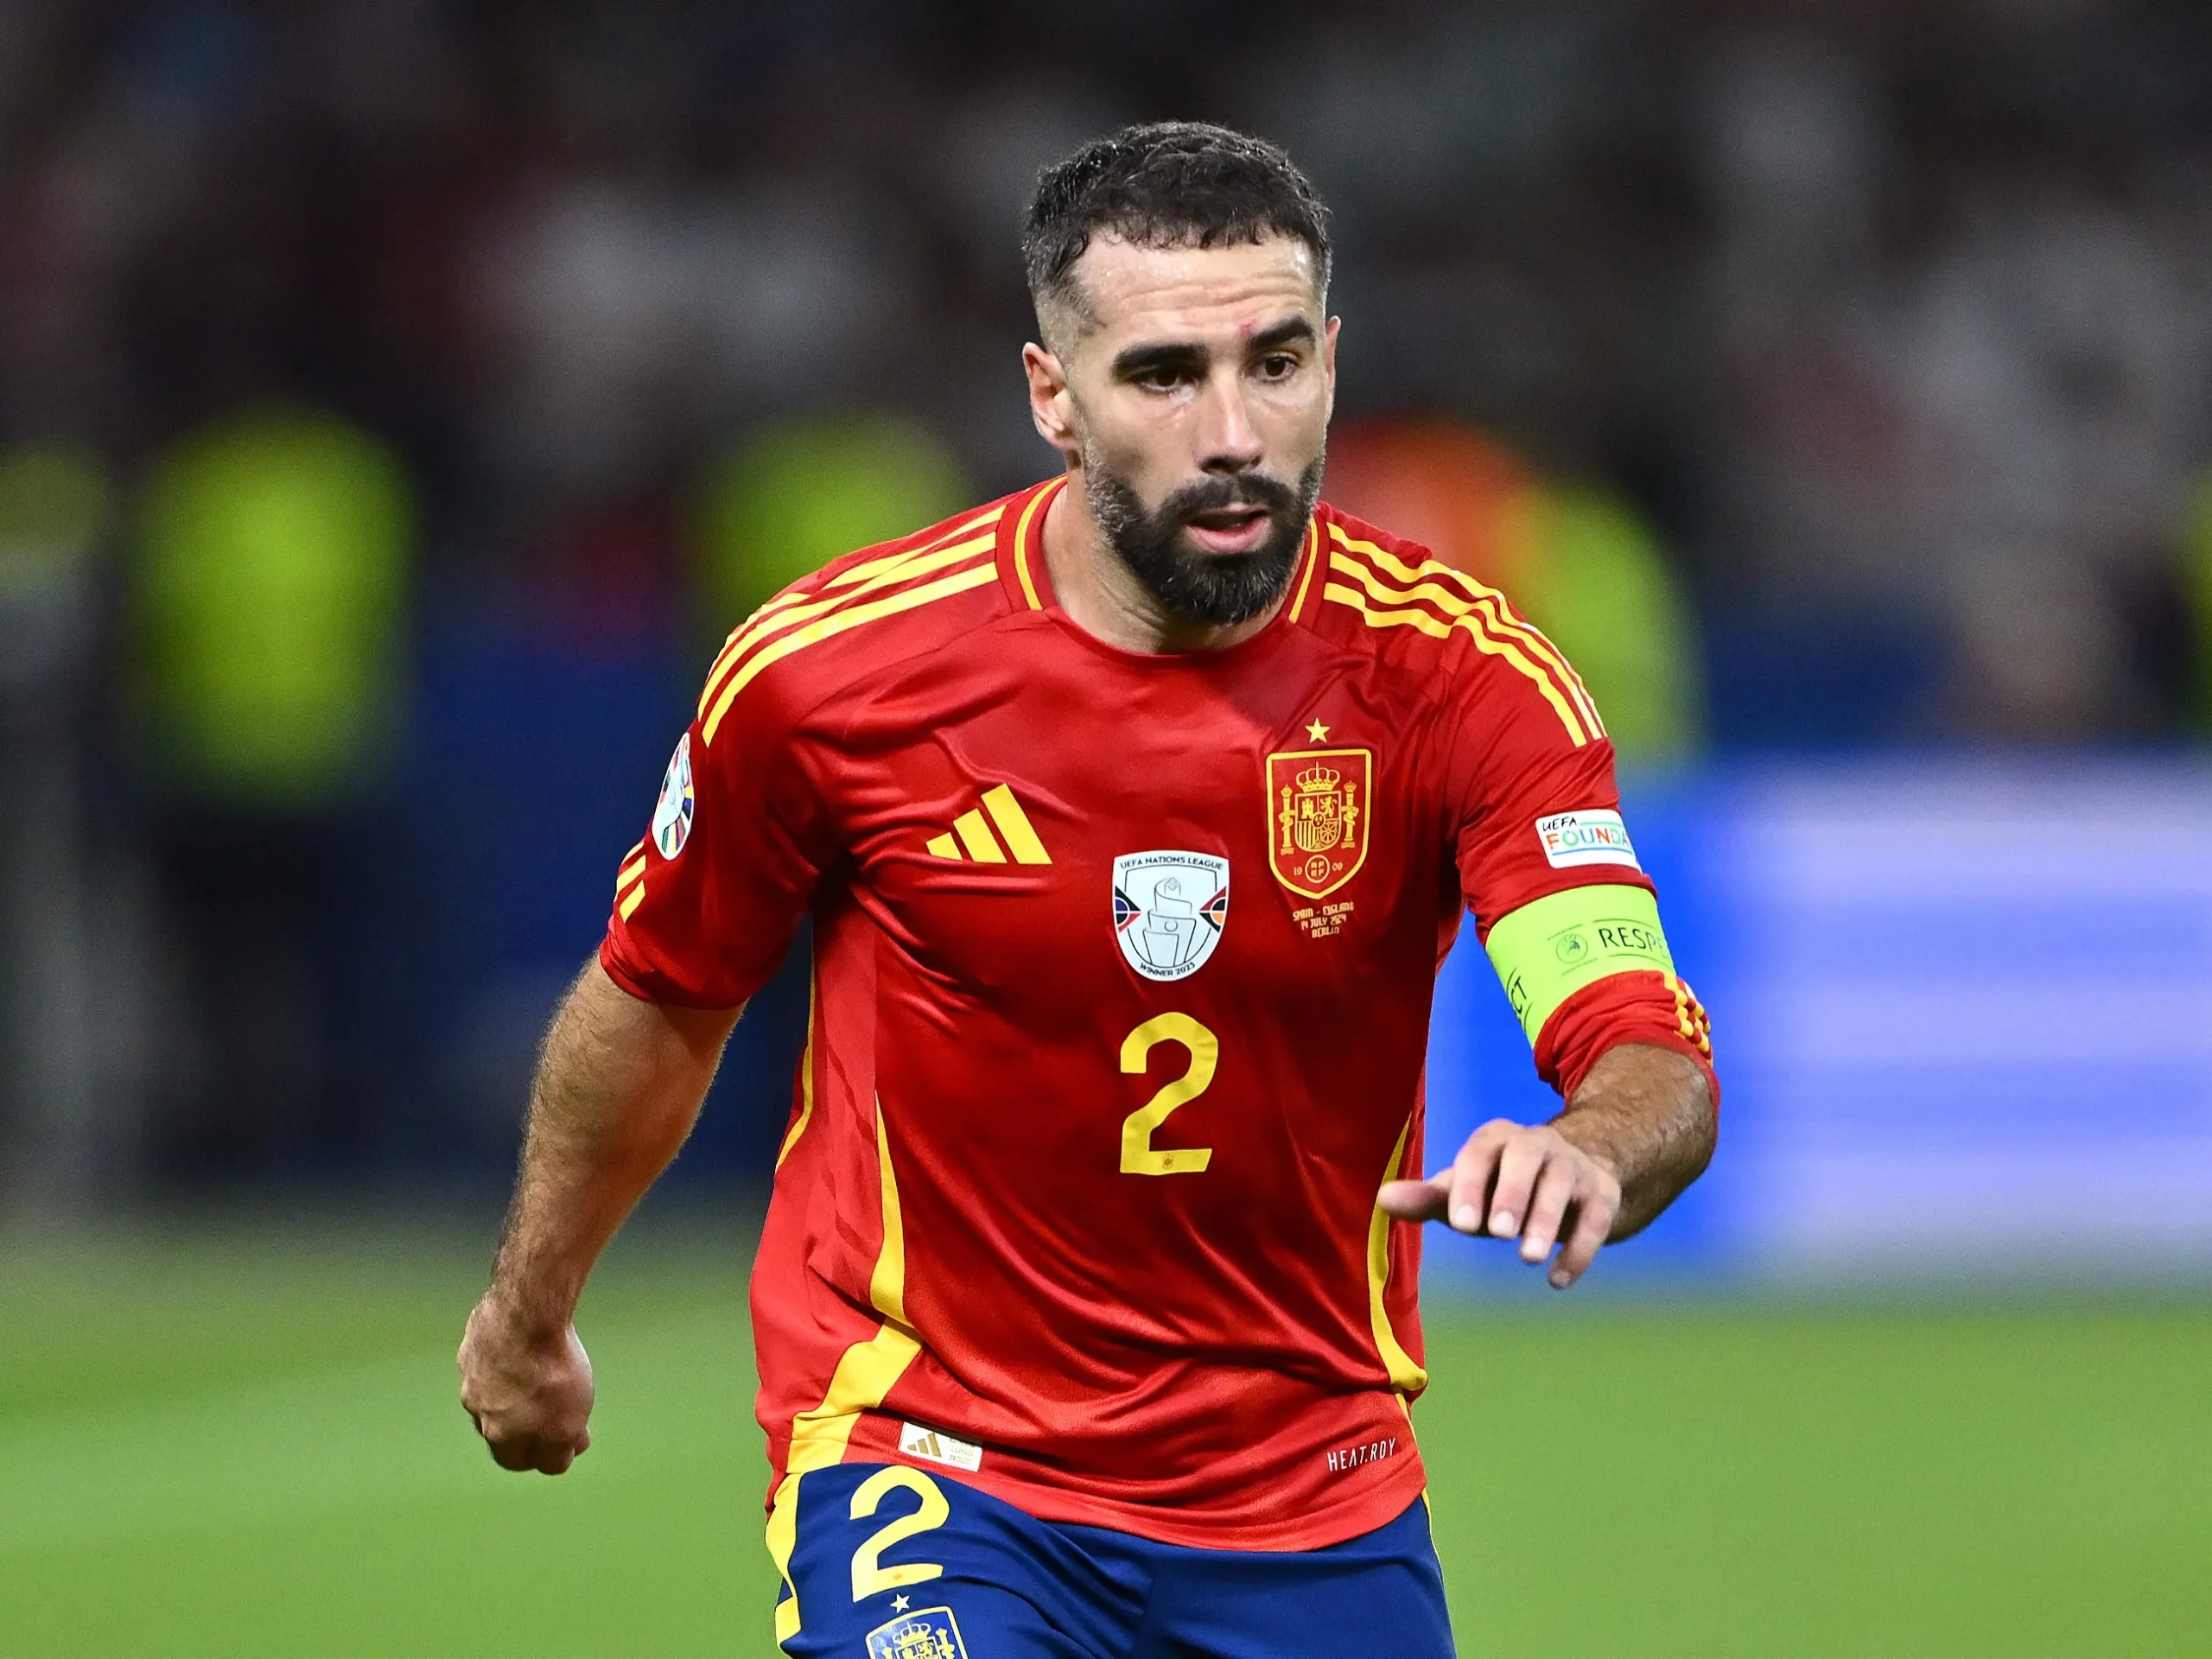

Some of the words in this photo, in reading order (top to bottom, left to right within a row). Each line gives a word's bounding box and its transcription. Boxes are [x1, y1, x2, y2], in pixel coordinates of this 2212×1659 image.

[1542, 816, 1577, 831] UEFA
[1120, 857, 1143, 869] UEFA
[1145, 855, 1185, 864] NATIONS
[1187, 857, 1224, 870] LEAGUE
[1293, 907, 1314, 922] SPAIN
[1322, 901, 1355, 916] ENGLAND
[1310, 917, 1328, 929] JULY
[1330, 913, 1347, 926] 2024
[1312, 926, 1340, 938] BERLIN
[1140, 962, 1173, 976] WINNER
[1175, 961, 1196, 975] 2023
[1120, 1012, 1219, 1176] 2
[1326, 1437, 1396, 1472] HEAT.RDY
[849, 1465, 950, 1603] 2
